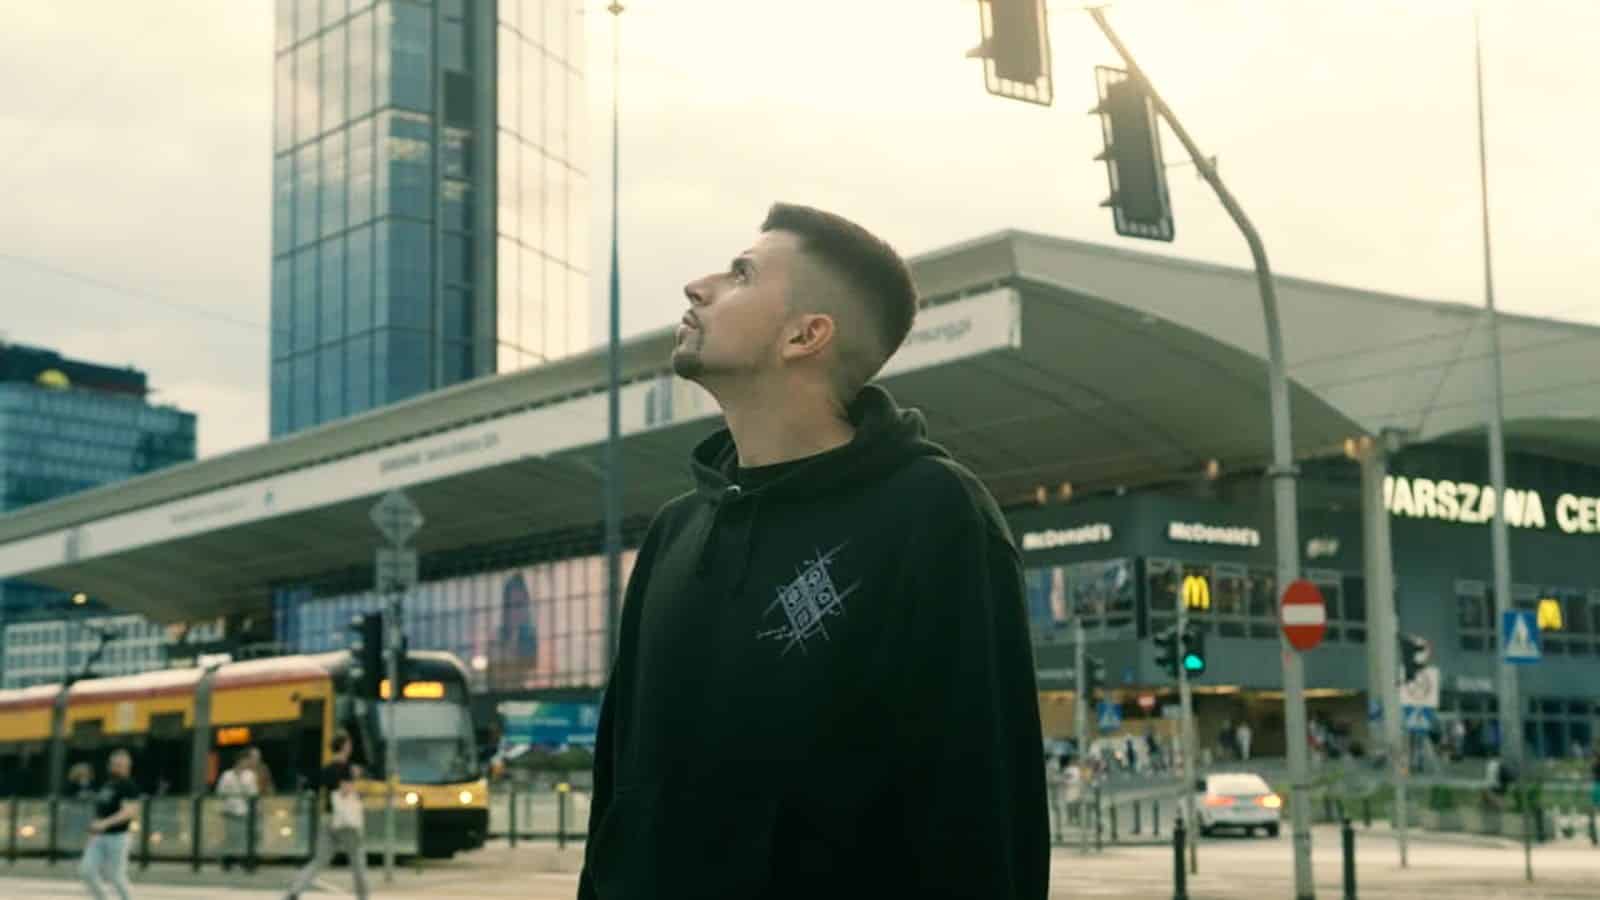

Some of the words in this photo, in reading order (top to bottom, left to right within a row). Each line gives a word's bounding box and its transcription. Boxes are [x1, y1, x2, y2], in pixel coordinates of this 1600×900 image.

[1555, 493, 1600, 534] CE
[1023, 523, 1112, 550] McDonald's
[1168, 522, 1260, 547] McDonald's
